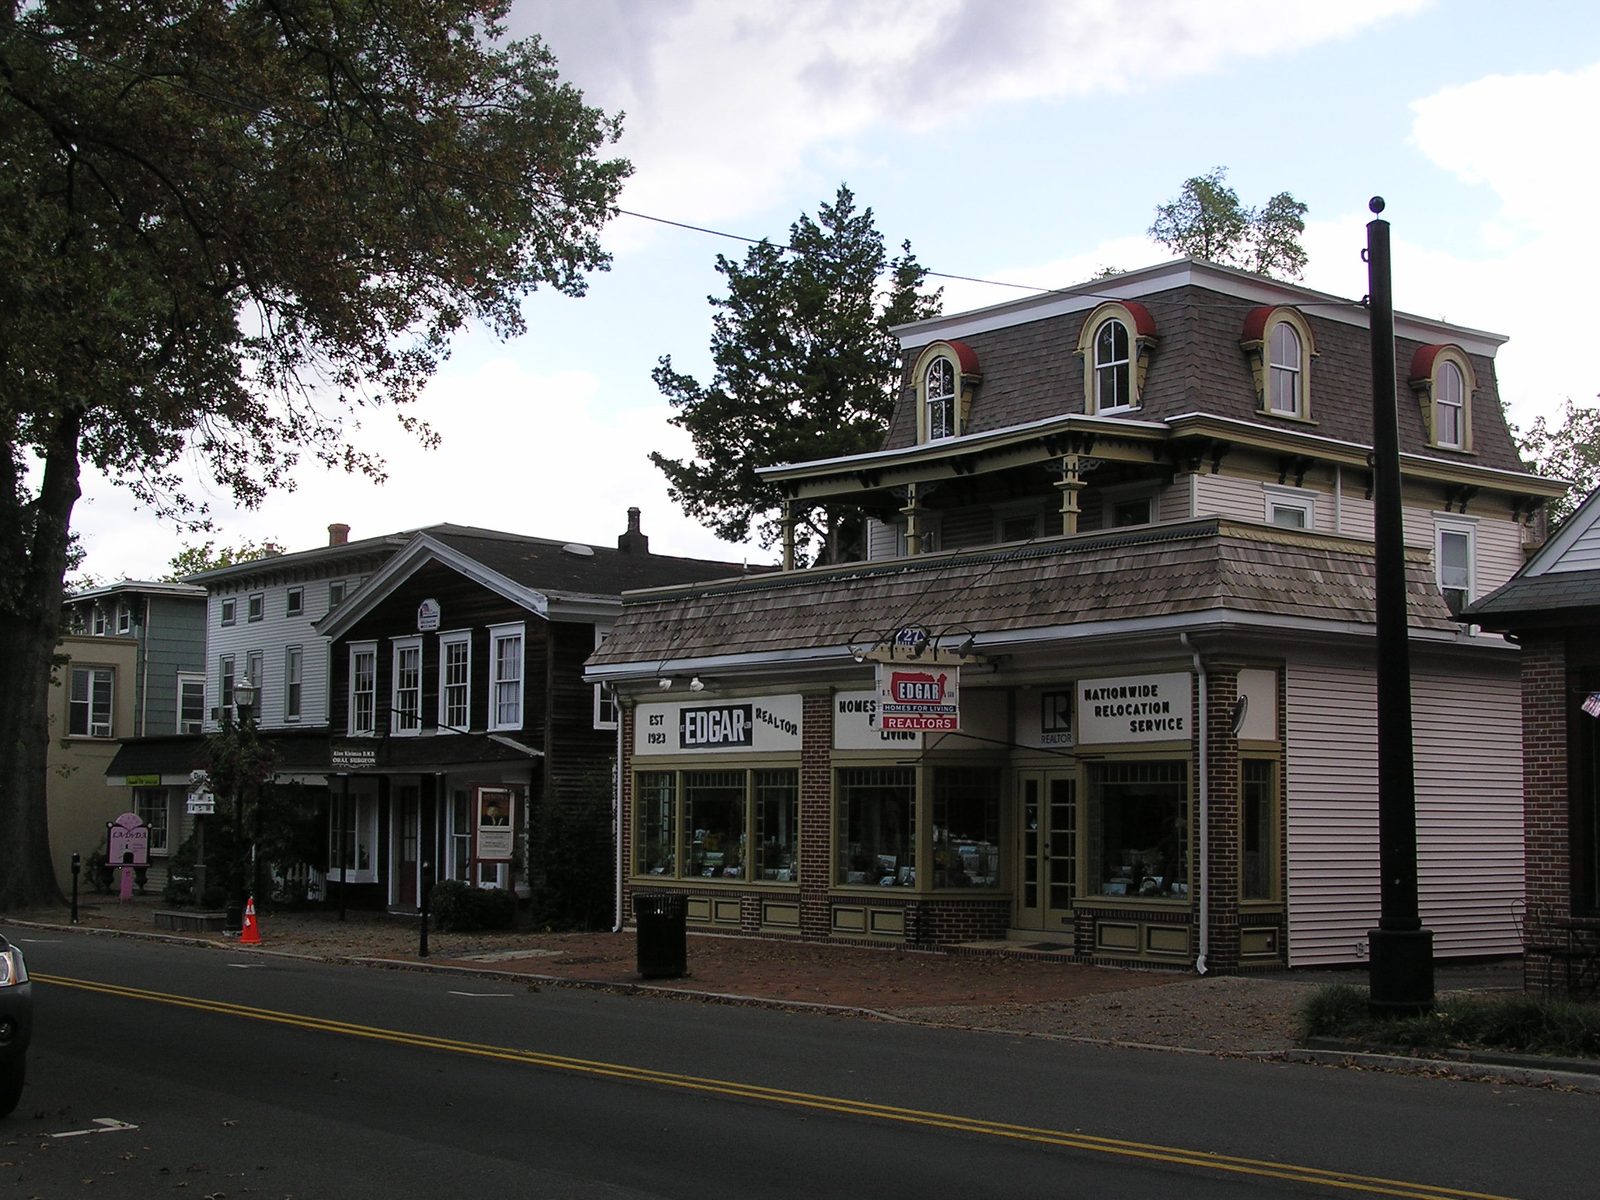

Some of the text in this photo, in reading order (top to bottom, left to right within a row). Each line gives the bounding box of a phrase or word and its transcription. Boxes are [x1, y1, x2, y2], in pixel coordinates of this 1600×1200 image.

[903, 628, 920, 641] 27
[899, 682, 939, 699] EDGAR
[1084, 684, 1158, 701] NATIONWIDE
[839, 700, 876, 713] HOMES
[1094, 701, 1170, 717] RELOCATION
[649, 714, 665, 726] EST
[685, 709, 745, 744] EDGAR
[755, 707, 798, 736] REALTOR
[888, 718, 951, 728] REALTORS
[1129, 717, 1183, 732] SERVICE
[647, 732, 666, 744] 1923
[1041, 733, 1072, 745] REALTOR
